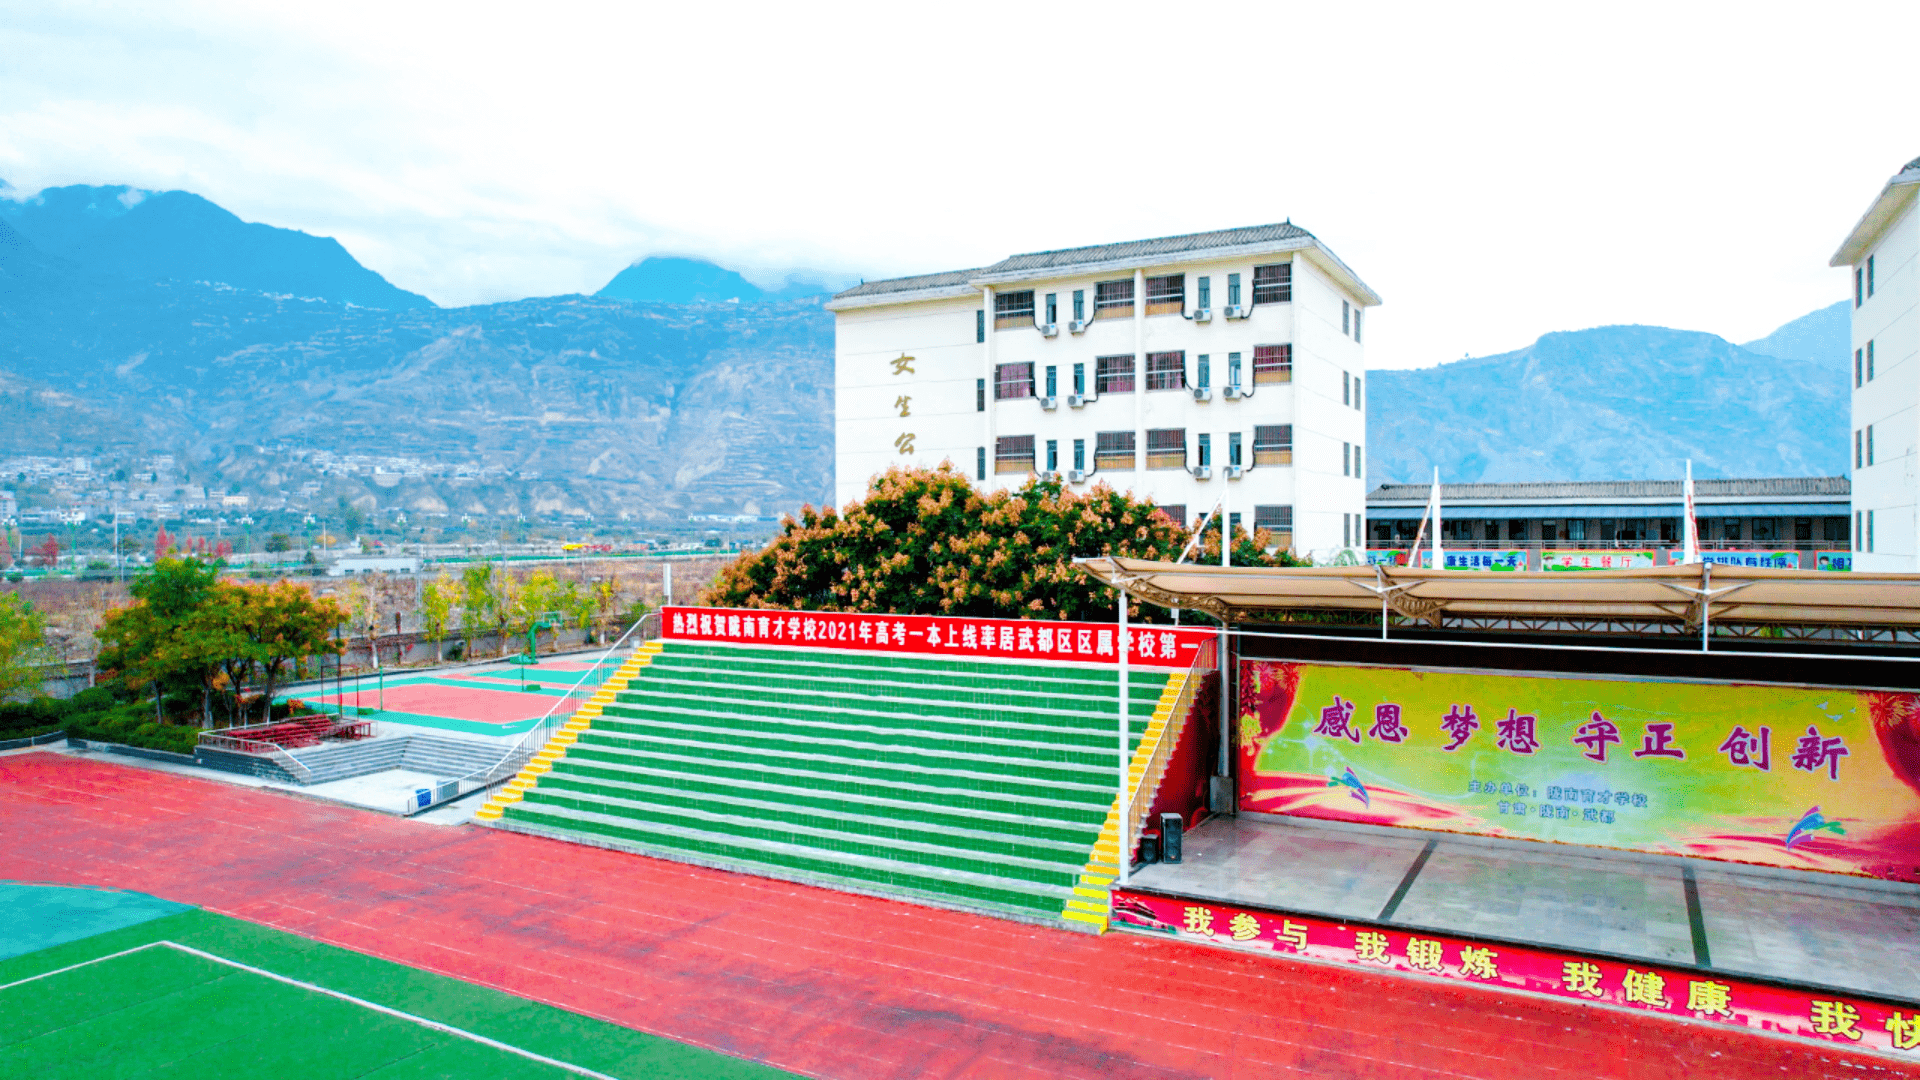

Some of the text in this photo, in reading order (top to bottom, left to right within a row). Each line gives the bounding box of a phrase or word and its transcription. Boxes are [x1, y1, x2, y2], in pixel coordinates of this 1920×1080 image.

[889, 352, 916, 456] 女生公
[1561, 555, 1633, 568] 学生餐厅
[1311, 694, 1850, 781] 感恩 梦想 守正 创新
[1183, 906, 1308, 950] 我参与
[1354, 931, 1499, 980] 我锻炼
[1561, 961, 1734, 1018] 我健康
